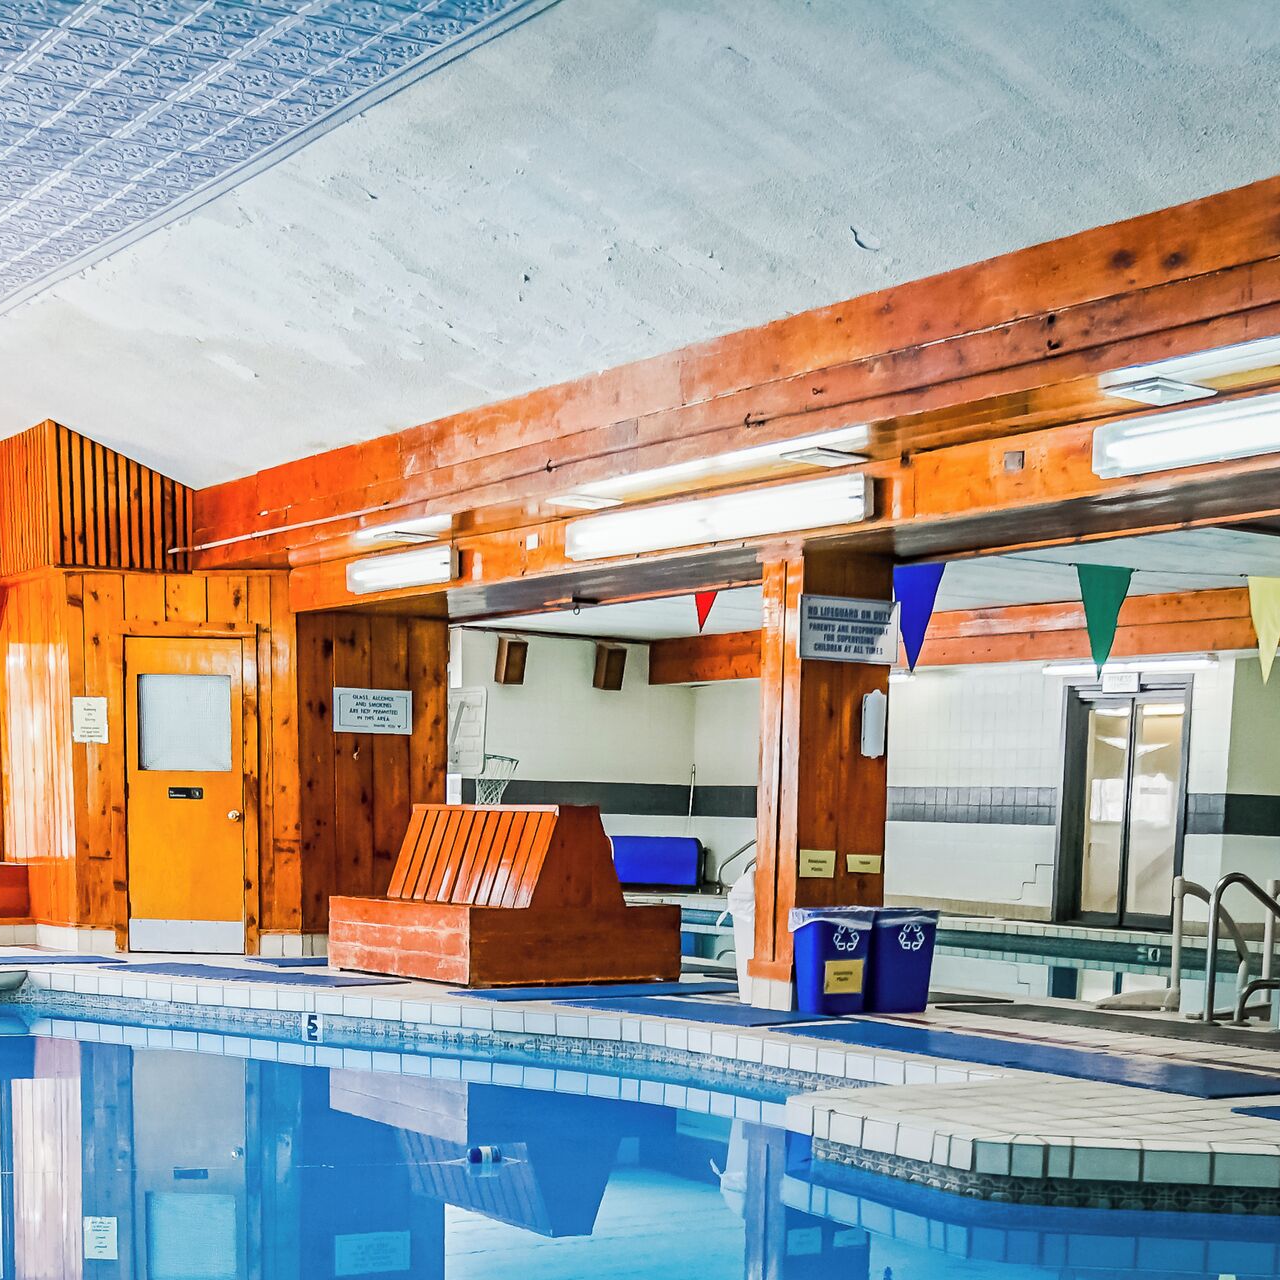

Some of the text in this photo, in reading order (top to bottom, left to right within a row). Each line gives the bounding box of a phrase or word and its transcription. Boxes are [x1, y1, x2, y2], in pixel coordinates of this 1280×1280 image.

[807, 606, 818, 615] NO
[820, 606, 858, 618] LIFEGUARD
[861, 610, 871, 619] ON
[809, 623, 888, 636] PARENTS ARE RESPONSIBLE
[823, 634, 874, 645] FOR SUPERVISING
[814, 643, 883, 655] CHILDREN AT ALL TIMES
[307, 1014, 318, 1030] 5
